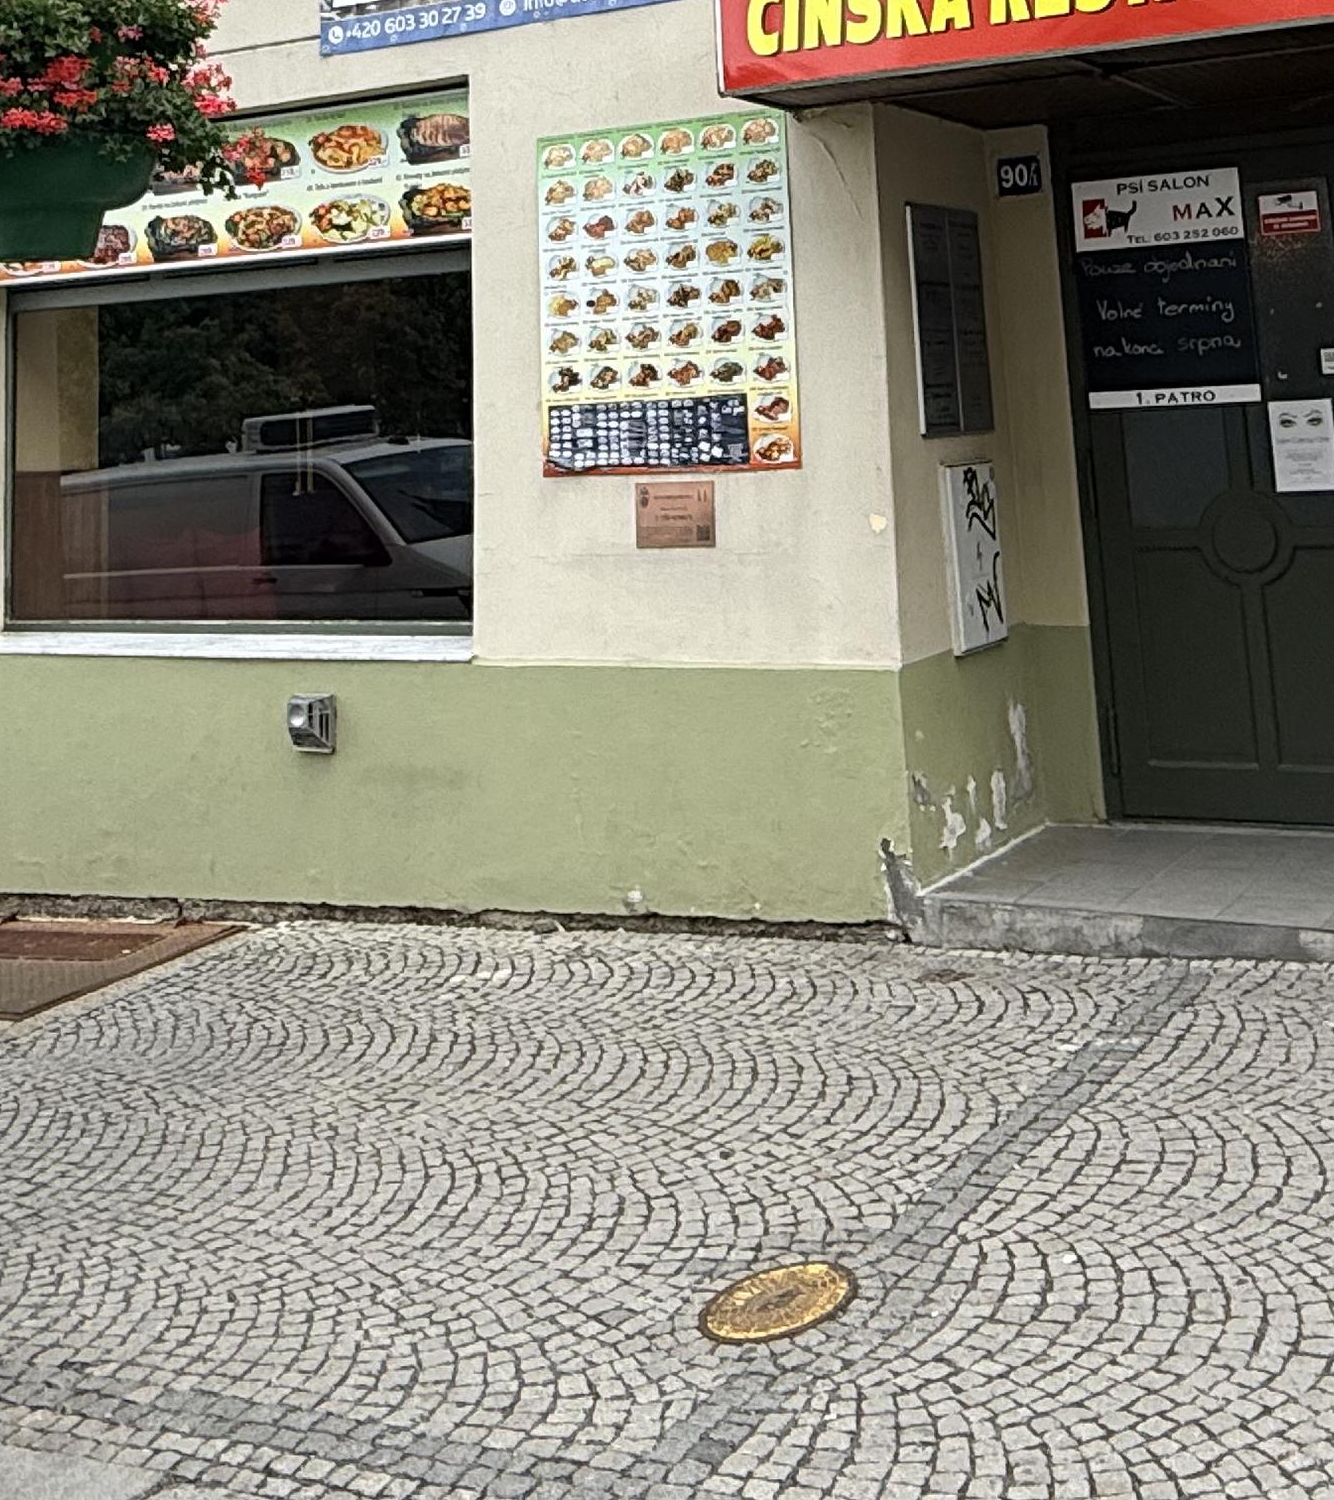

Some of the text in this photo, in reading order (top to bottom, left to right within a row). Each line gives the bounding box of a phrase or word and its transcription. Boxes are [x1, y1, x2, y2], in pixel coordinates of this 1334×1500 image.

[384, 15, 417, 35] 603
[419, 10, 440, 30] 30
[441, 6, 462, 25] 27
[464, 2, 487, 22] 39
[1147, 174, 1210, 193] SALON
[1172, 196, 1236, 221] MAX
[1154, 230, 1181, 242] 603
[1155, 389, 1216, 404] PATRO
